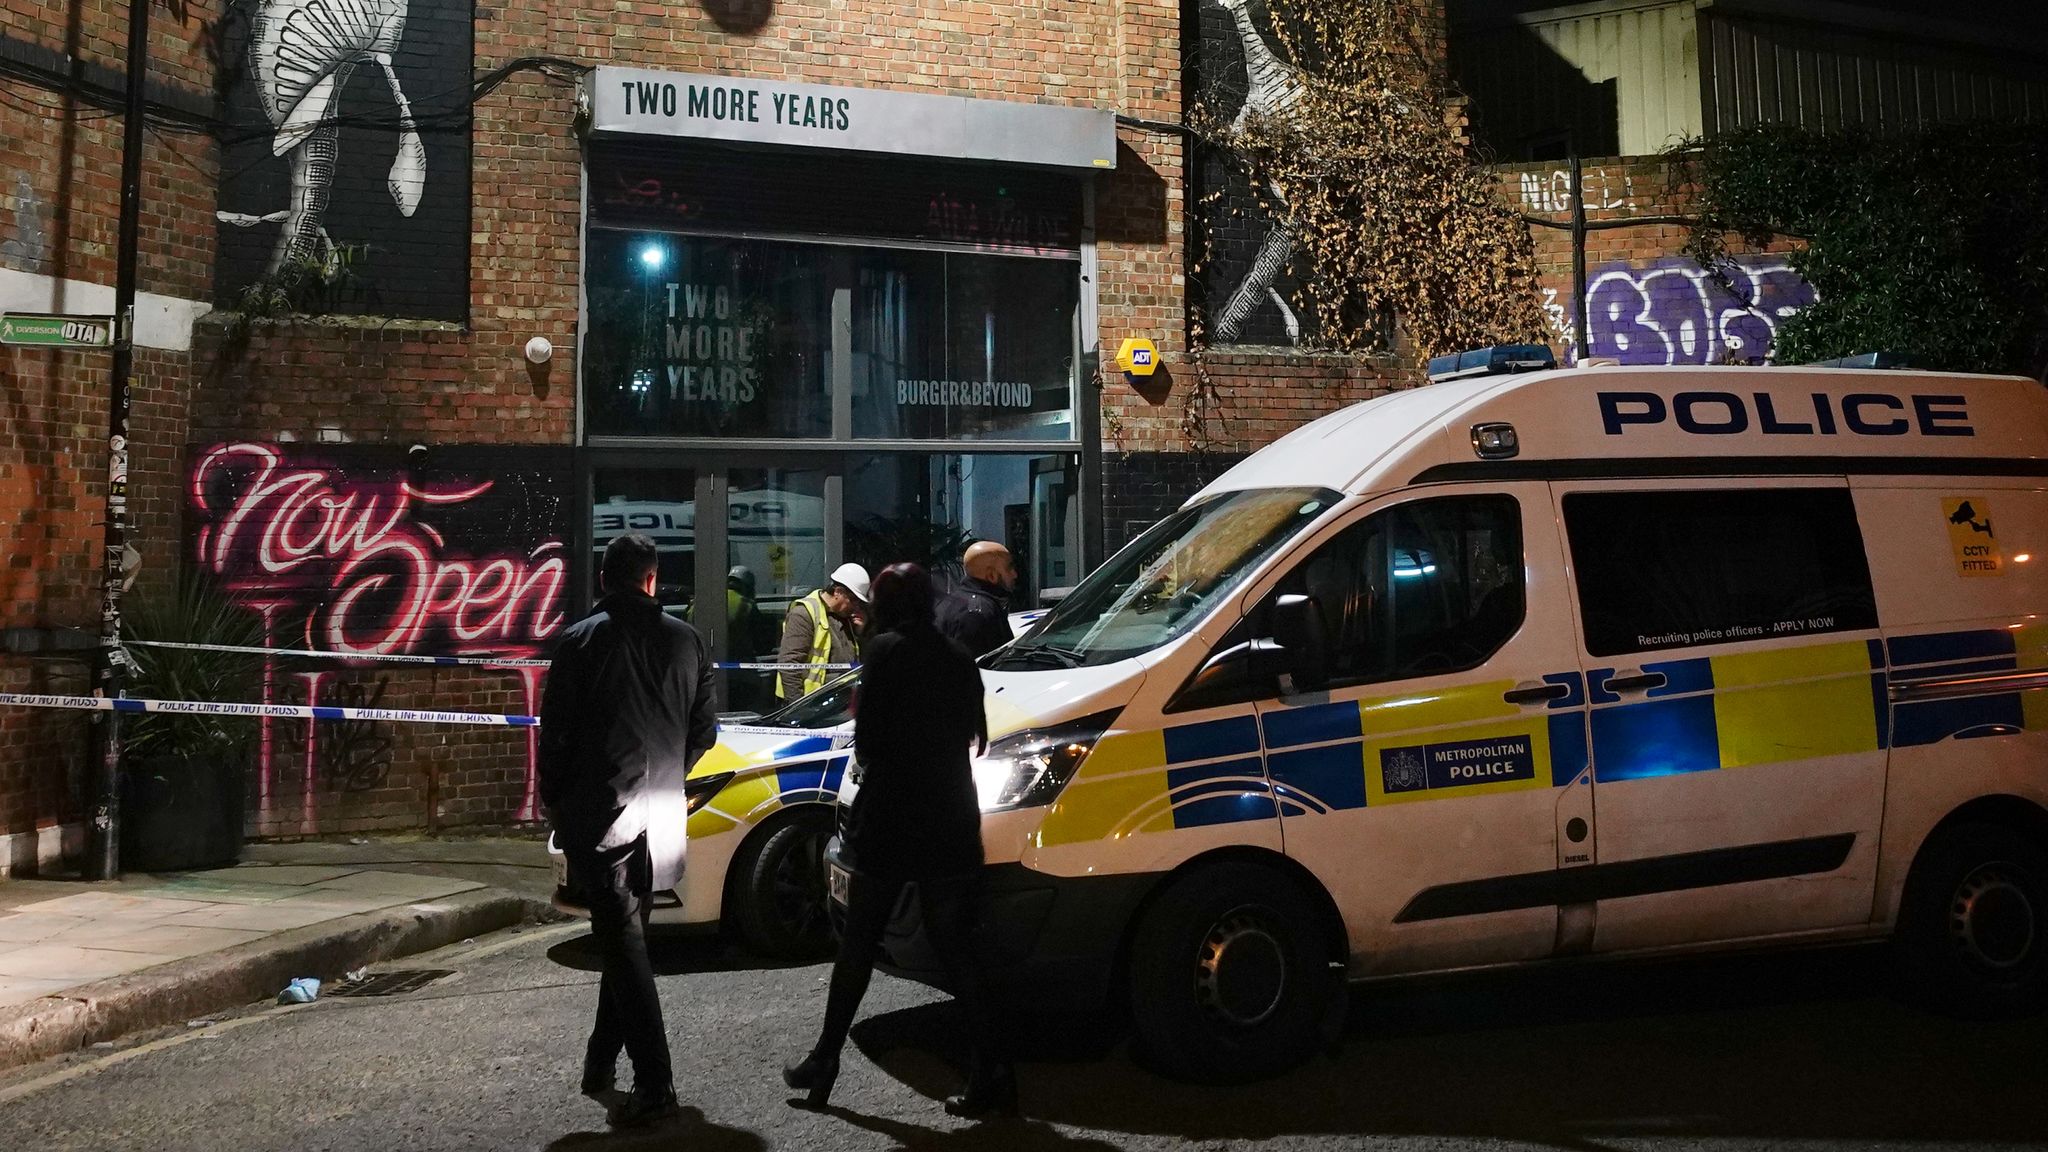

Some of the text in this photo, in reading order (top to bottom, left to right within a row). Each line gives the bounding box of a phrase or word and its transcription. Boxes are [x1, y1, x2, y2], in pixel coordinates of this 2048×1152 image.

[622, 81, 850, 130] TWO MORE YEARS
[666, 283, 729, 319] TWO
[16, 326, 60, 335] DIVERSION
[666, 324, 754, 361] MORE
[1133, 352, 1150, 363] ADT
[667, 365, 755, 402] YEARS
[897, 380, 1032, 407] BURGER&BEYOND
[1597, 391, 1975, 437] POLICE
[1963, 546, 1989, 556] CCTV
[1962, 560, 1997, 570] FITTED
[1638, 633, 1690, 646] Recruiting
[1693, 628, 1723, 642] police
[1726, 625, 1763, 637] officers
[1773, 620, 1805, 632] APPLY
[1808, 617, 1834, 629] NOW
[356, 709, 391, 719] POLICE
[395, 711, 417, 720] LINE
[1435, 744, 1524, 763] METROPOLITAN
[1450, 761, 1514, 779] POLICE
[1564, 854, 1590, 863] DIESEL
